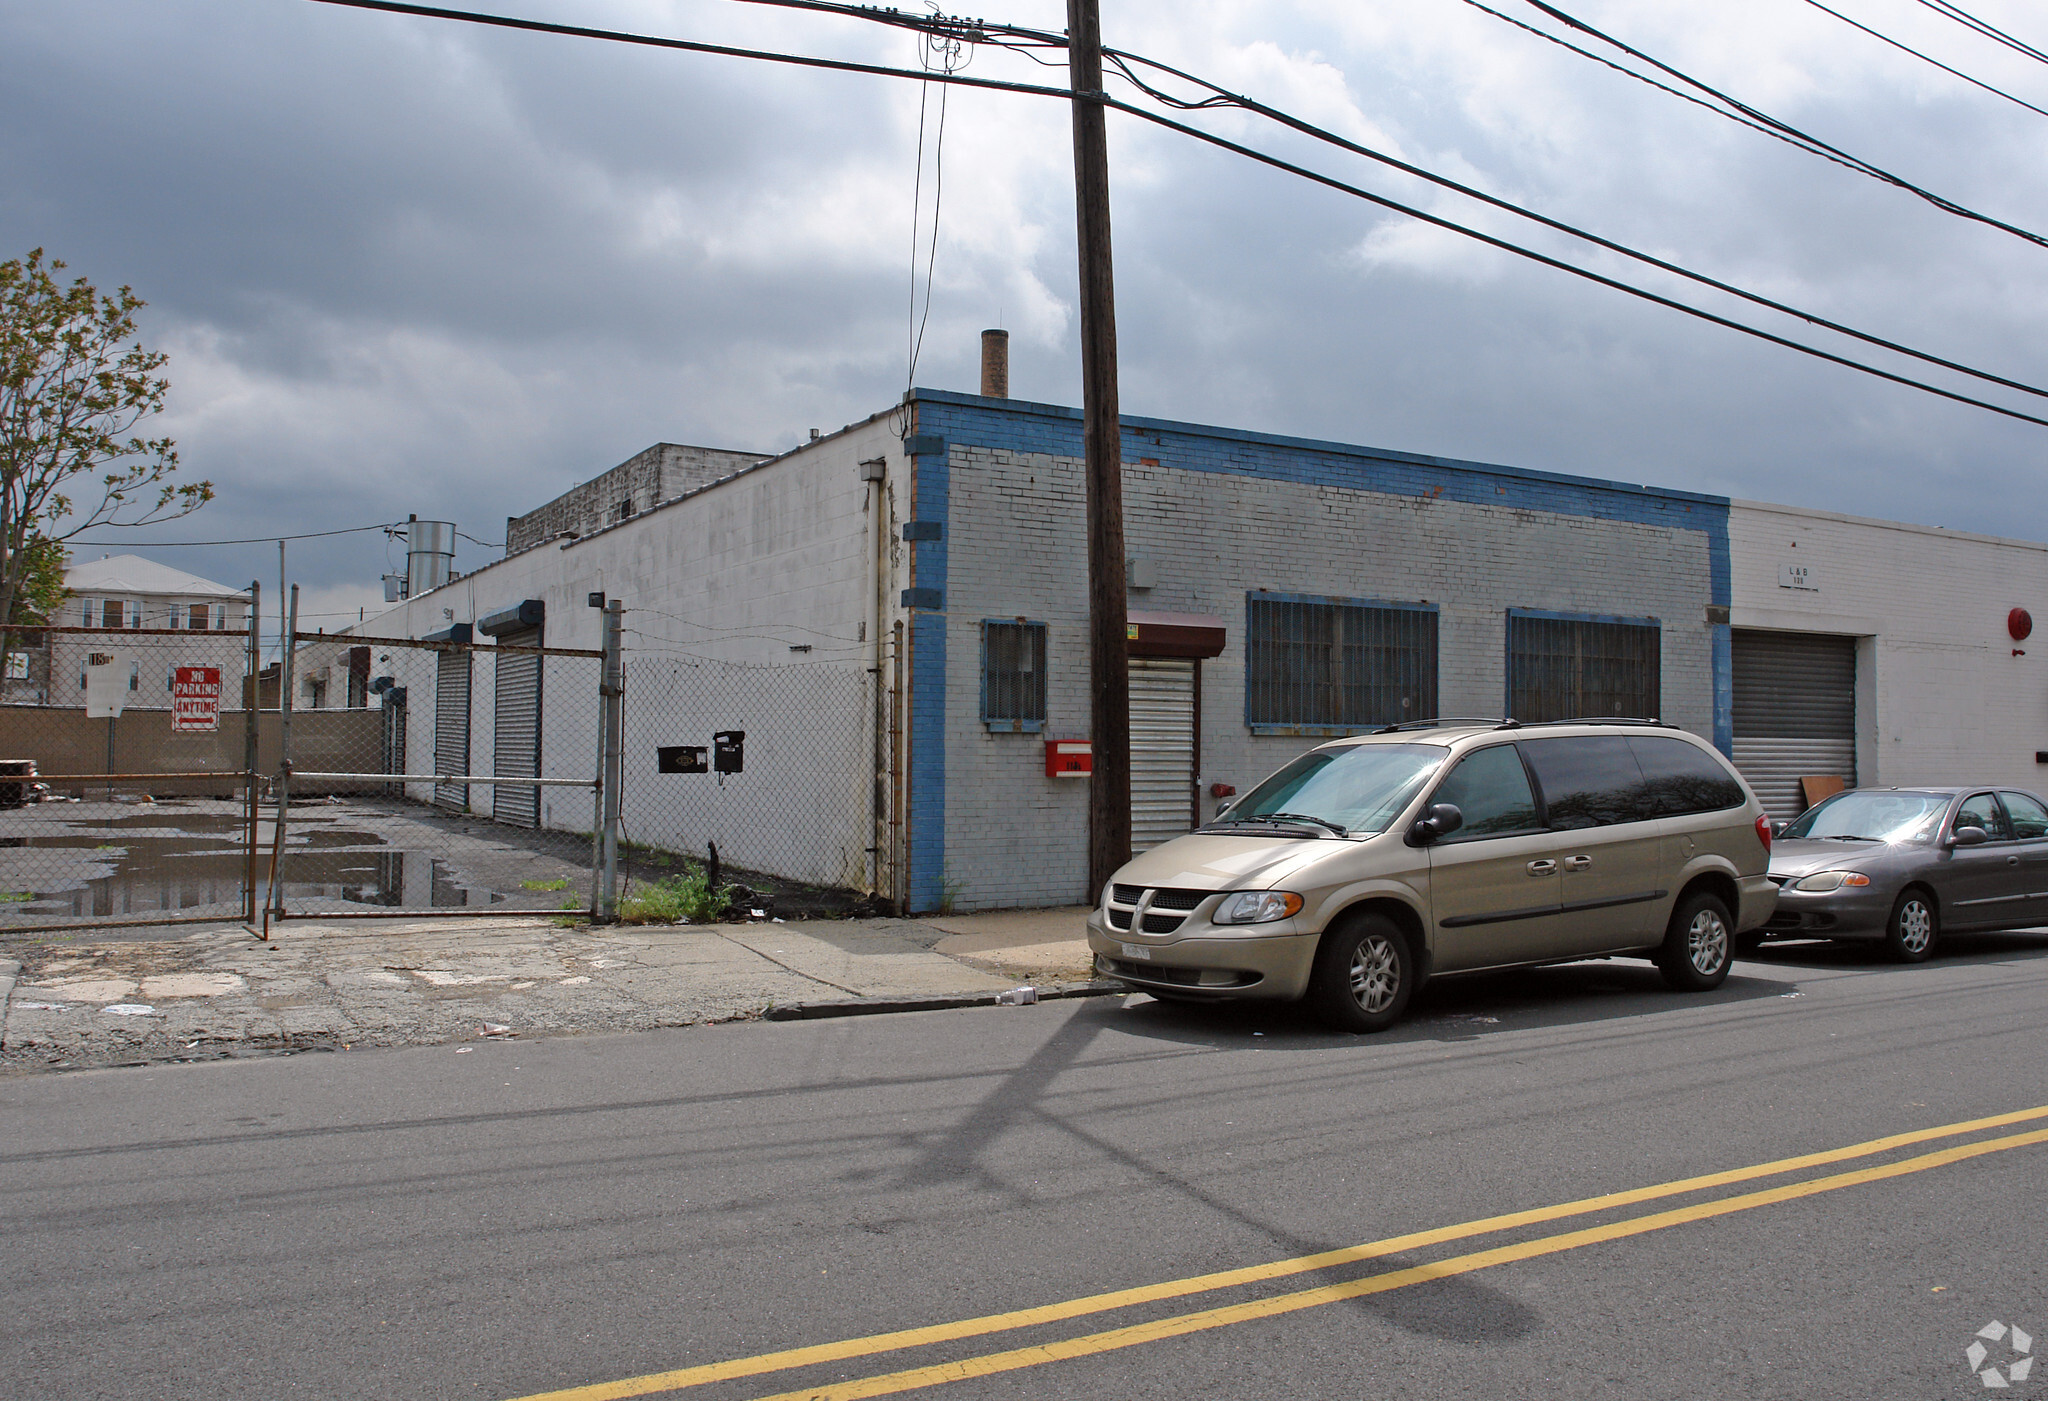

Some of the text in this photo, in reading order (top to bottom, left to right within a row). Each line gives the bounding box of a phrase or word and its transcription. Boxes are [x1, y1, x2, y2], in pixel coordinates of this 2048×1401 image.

[191, 670, 205, 683] NO
[176, 682, 218, 696] PARKING
[176, 701, 217, 713] ANYTIME
